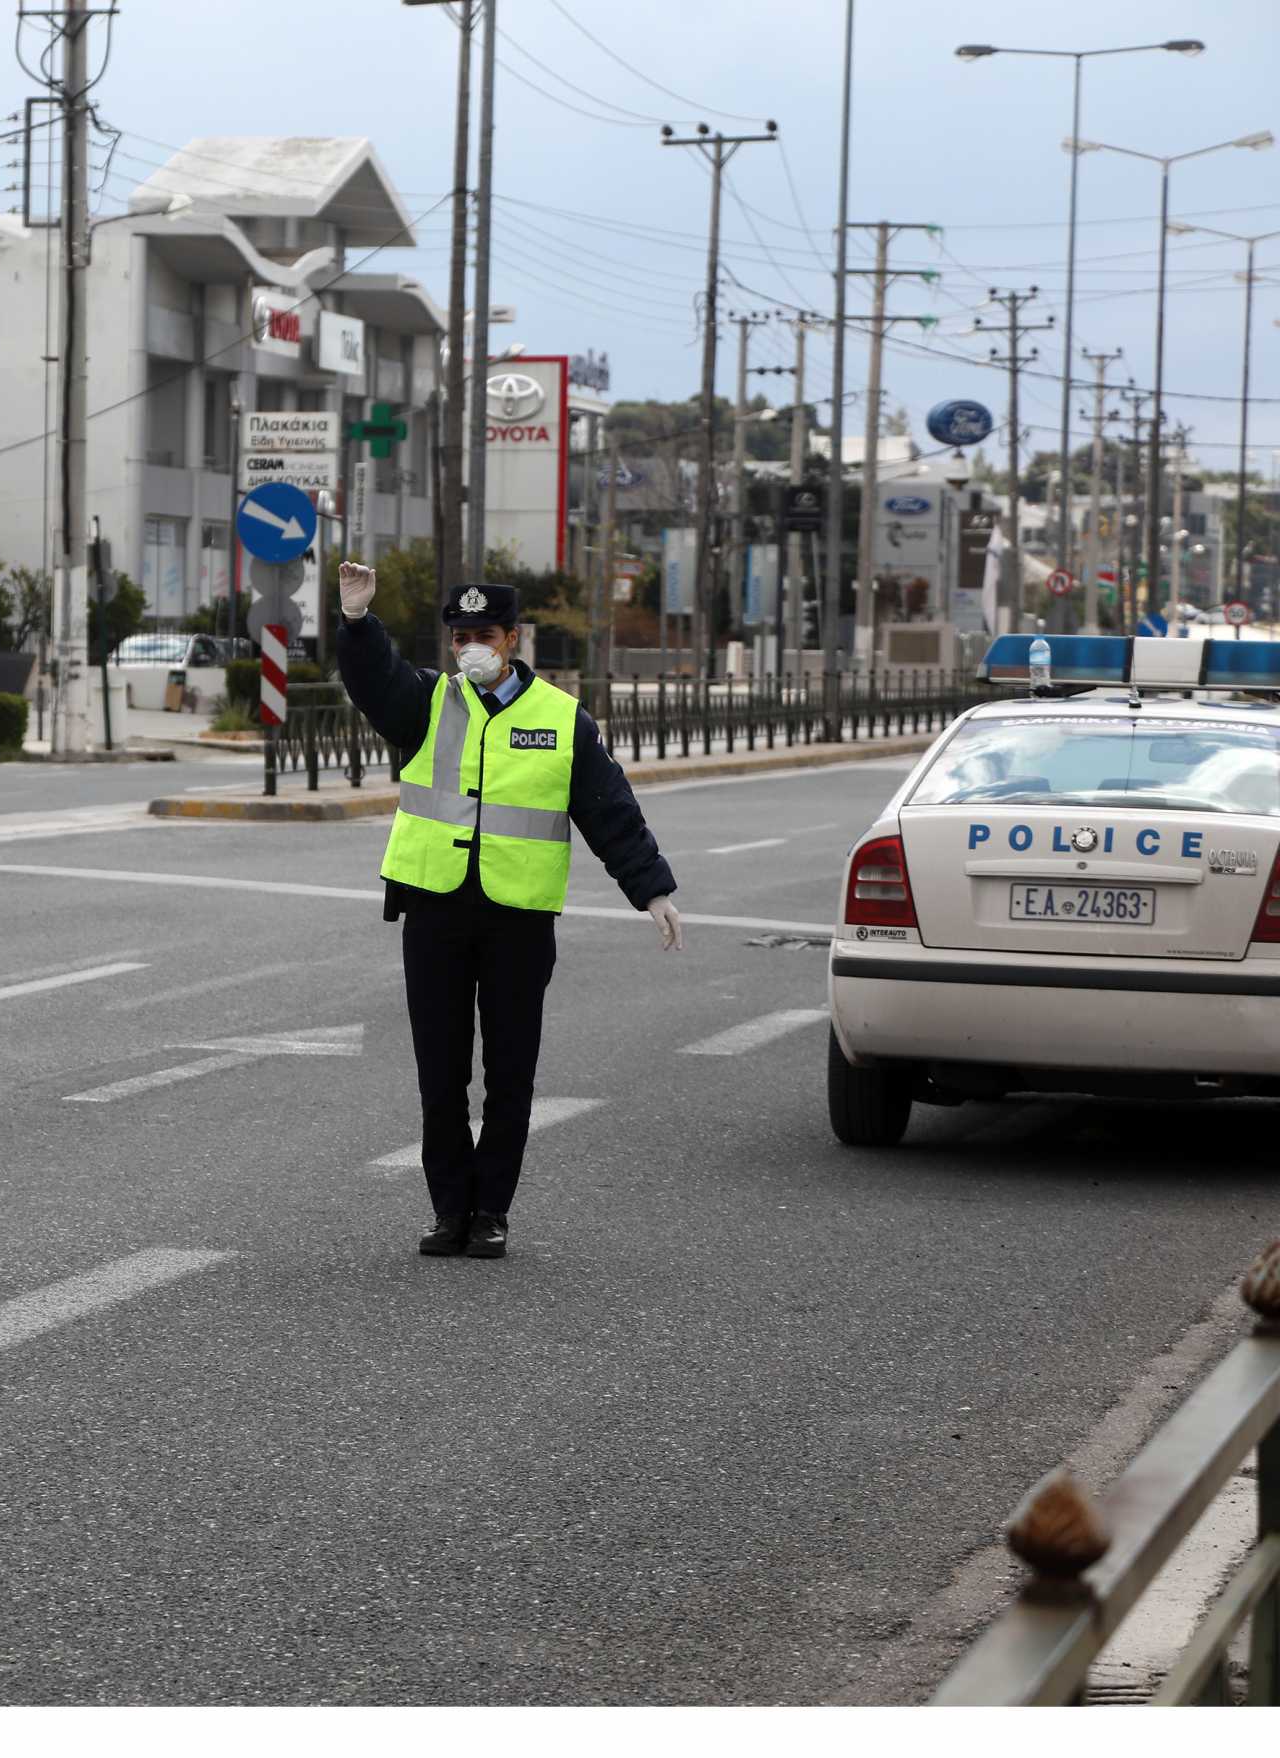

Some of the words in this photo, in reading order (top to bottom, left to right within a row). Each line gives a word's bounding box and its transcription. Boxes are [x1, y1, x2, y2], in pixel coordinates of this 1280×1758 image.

[249, 416, 329, 432] Πλακάκια
[485, 426, 550, 442] OYOTA
[246, 458, 285, 471] CERAM
[511, 732, 556, 746] POLICE
[968, 824, 1204, 859] POLICE
[1077, 890, 1142, 919] 24363
